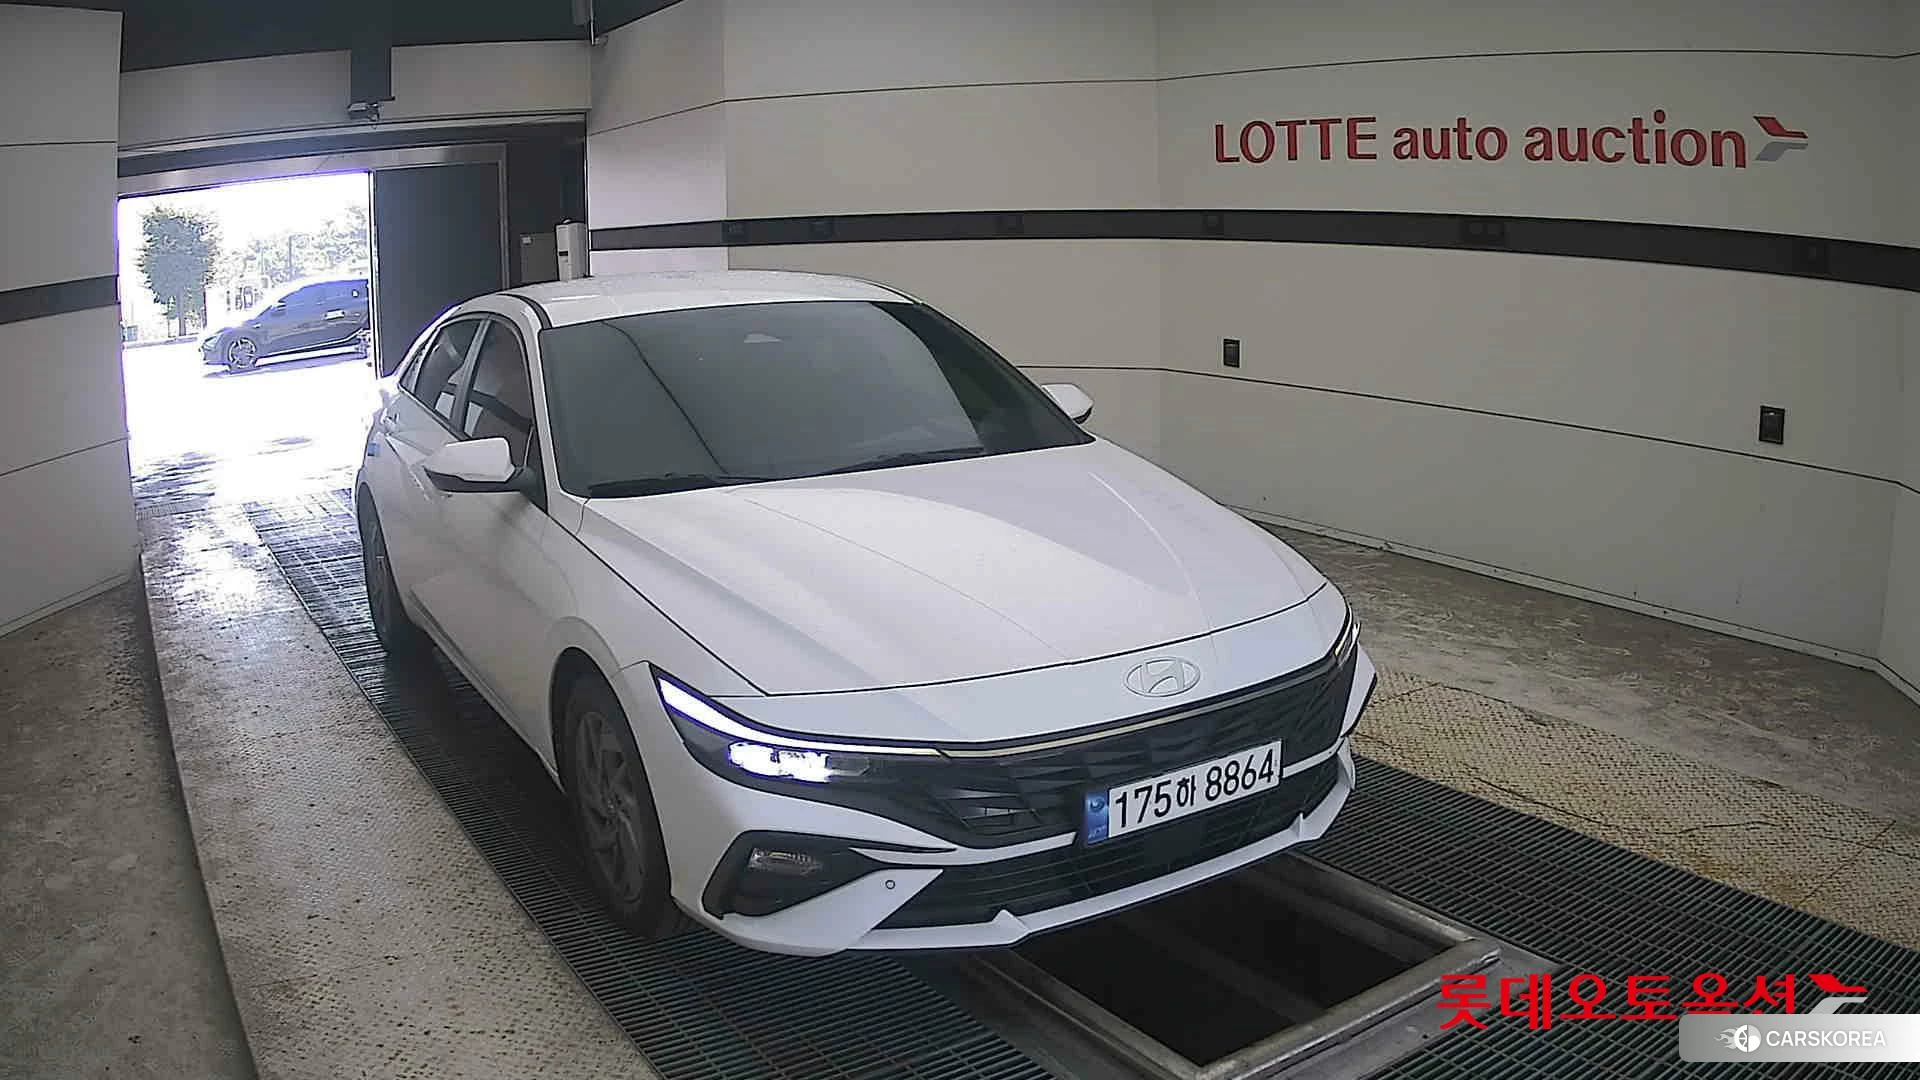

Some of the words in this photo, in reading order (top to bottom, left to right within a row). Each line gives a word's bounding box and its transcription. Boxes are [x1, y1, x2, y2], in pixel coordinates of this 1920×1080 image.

[1214, 116, 1377, 163] LOTTE
[1392, 116, 1509, 161] auto
[1523, 109, 1747, 168] auction
[1115, 774, 1197, 828] 175하
[1205, 748, 1274, 802] 8864
